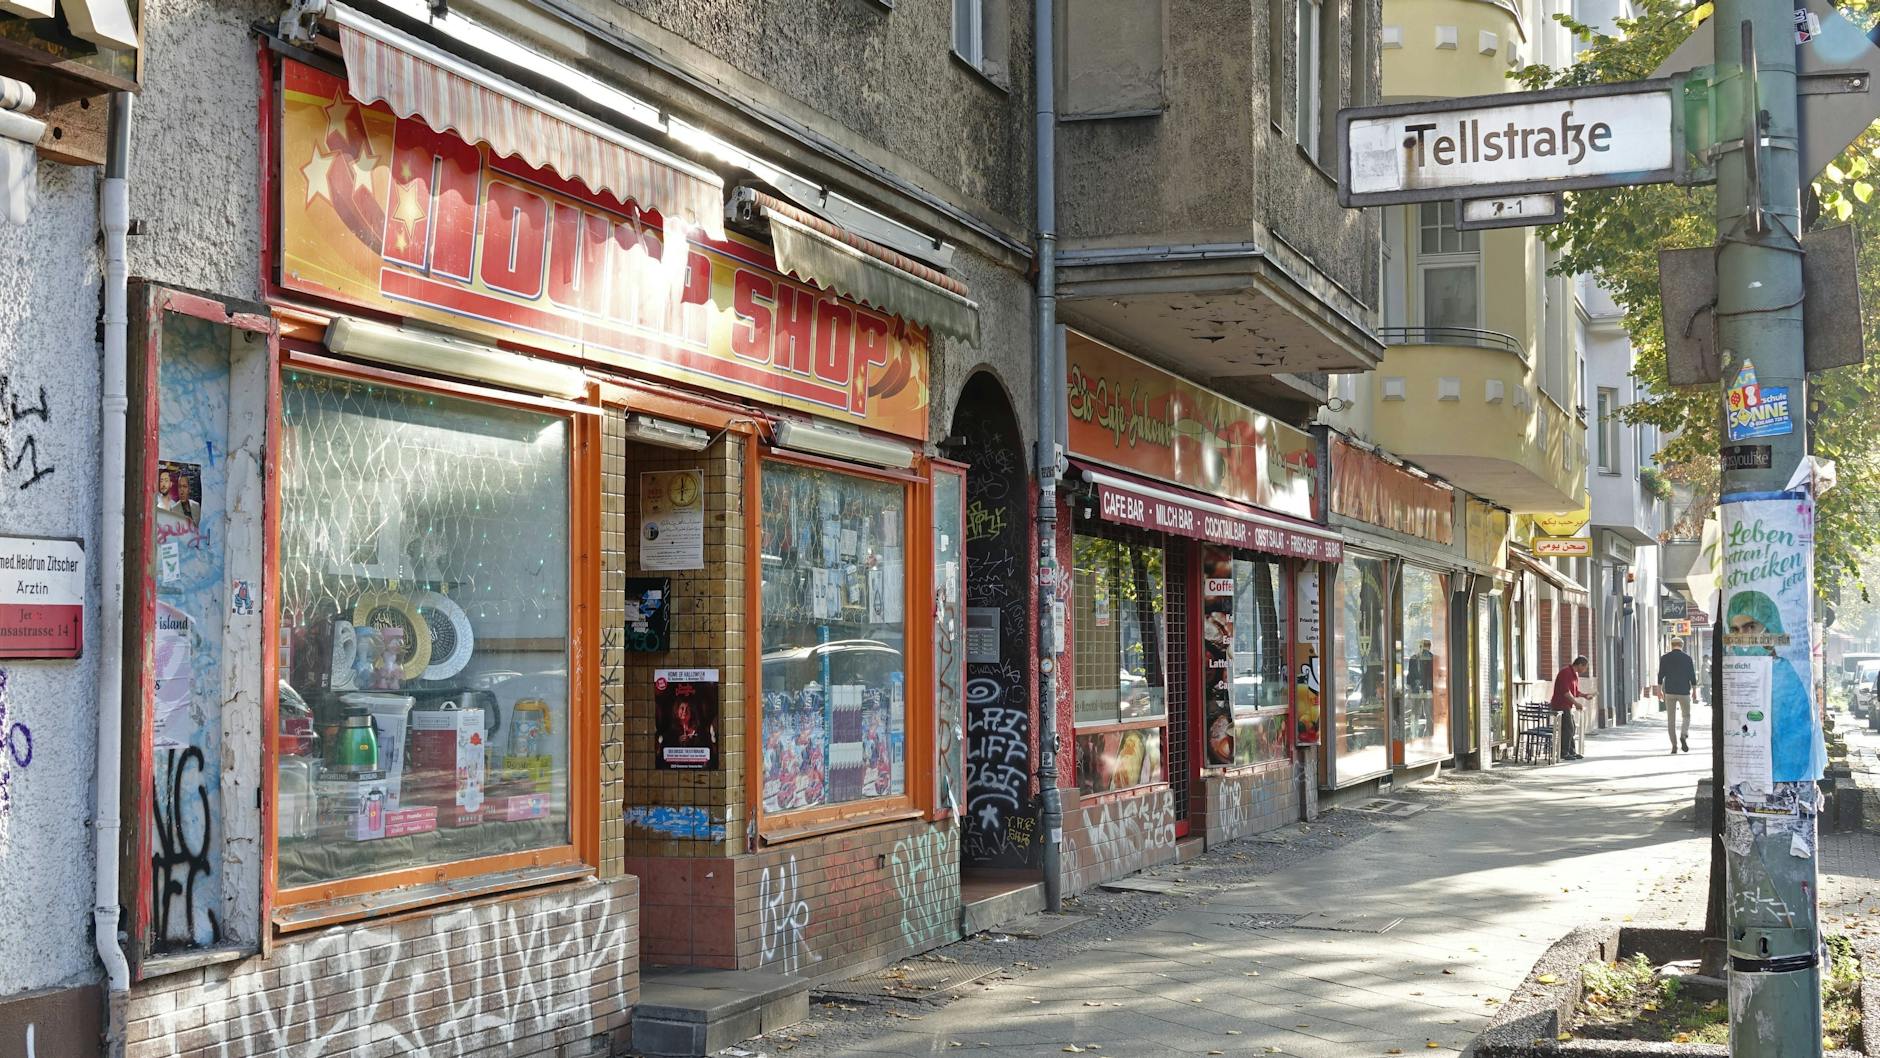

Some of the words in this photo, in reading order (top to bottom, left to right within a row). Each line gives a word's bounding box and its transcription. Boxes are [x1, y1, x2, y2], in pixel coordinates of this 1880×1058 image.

[1404, 110, 1613, 167] Tellstraße
[731, 267, 889, 418] SHOP
[1095, 377, 1127, 449] Cafe
[1103, 491, 1126, 520] CAFE
[1126, 497, 1144, 522] BAR
[1156, 503, 1178, 528] MILCH
[1178, 509, 1193, 531] BAR
[1729, 519, 1795, 548] Leben
[16, 554, 45, 571] Heidrun
[47, 555, 79, 573] Zitscher
[1726, 551, 1801, 590] streiken
[16, 579, 49, 595] Ärztin
[57, 624, 69, 637] 14
[159, 615, 188, 630] island
